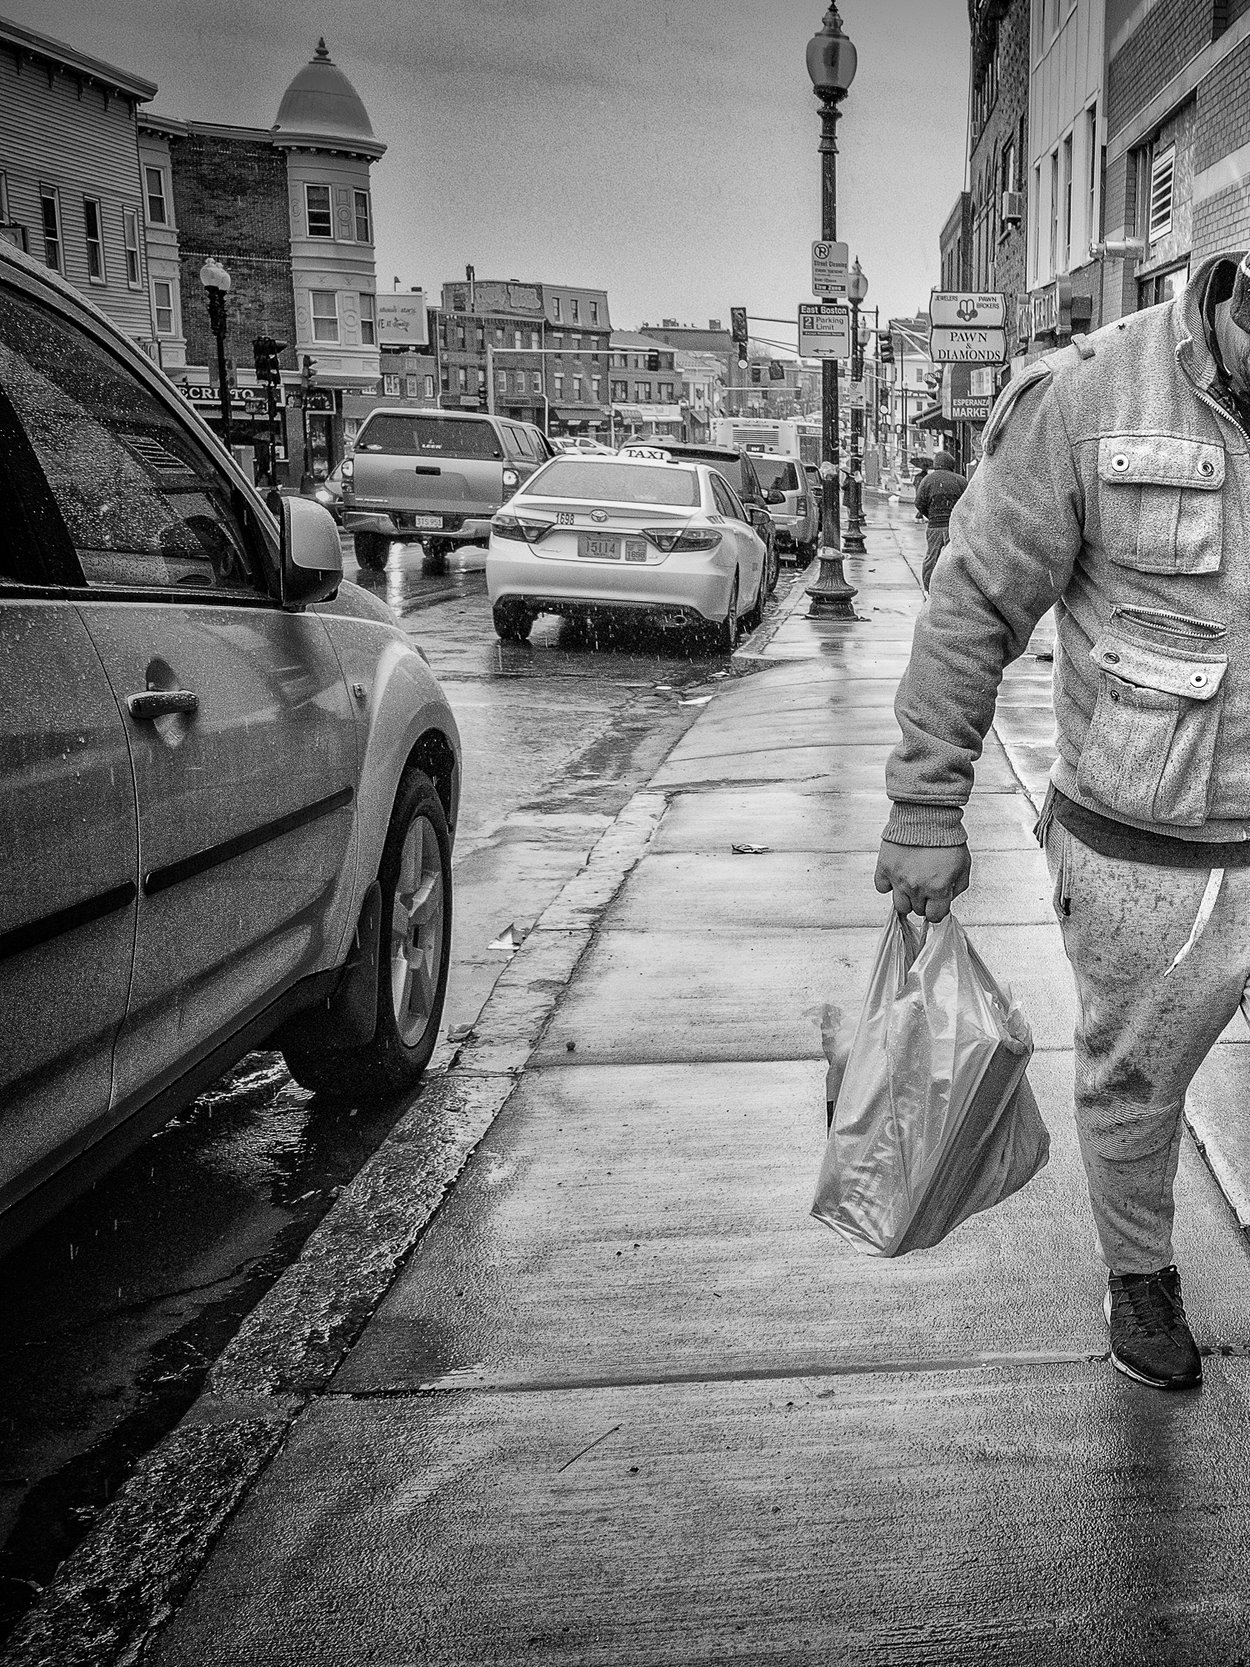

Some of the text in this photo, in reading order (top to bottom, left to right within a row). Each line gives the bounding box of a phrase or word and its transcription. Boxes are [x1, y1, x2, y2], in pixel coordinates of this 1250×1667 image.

[801, 305, 847, 315] East Boston
[816, 316, 844, 325] Parking
[950, 332, 987, 342] PAWN
[938, 349, 1001, 360] DIAMONDS
[180, 387, 255, 400] ECRITO
[626, 449, 665, 460] TAXI
[556, 513, 575, 525] 1698
